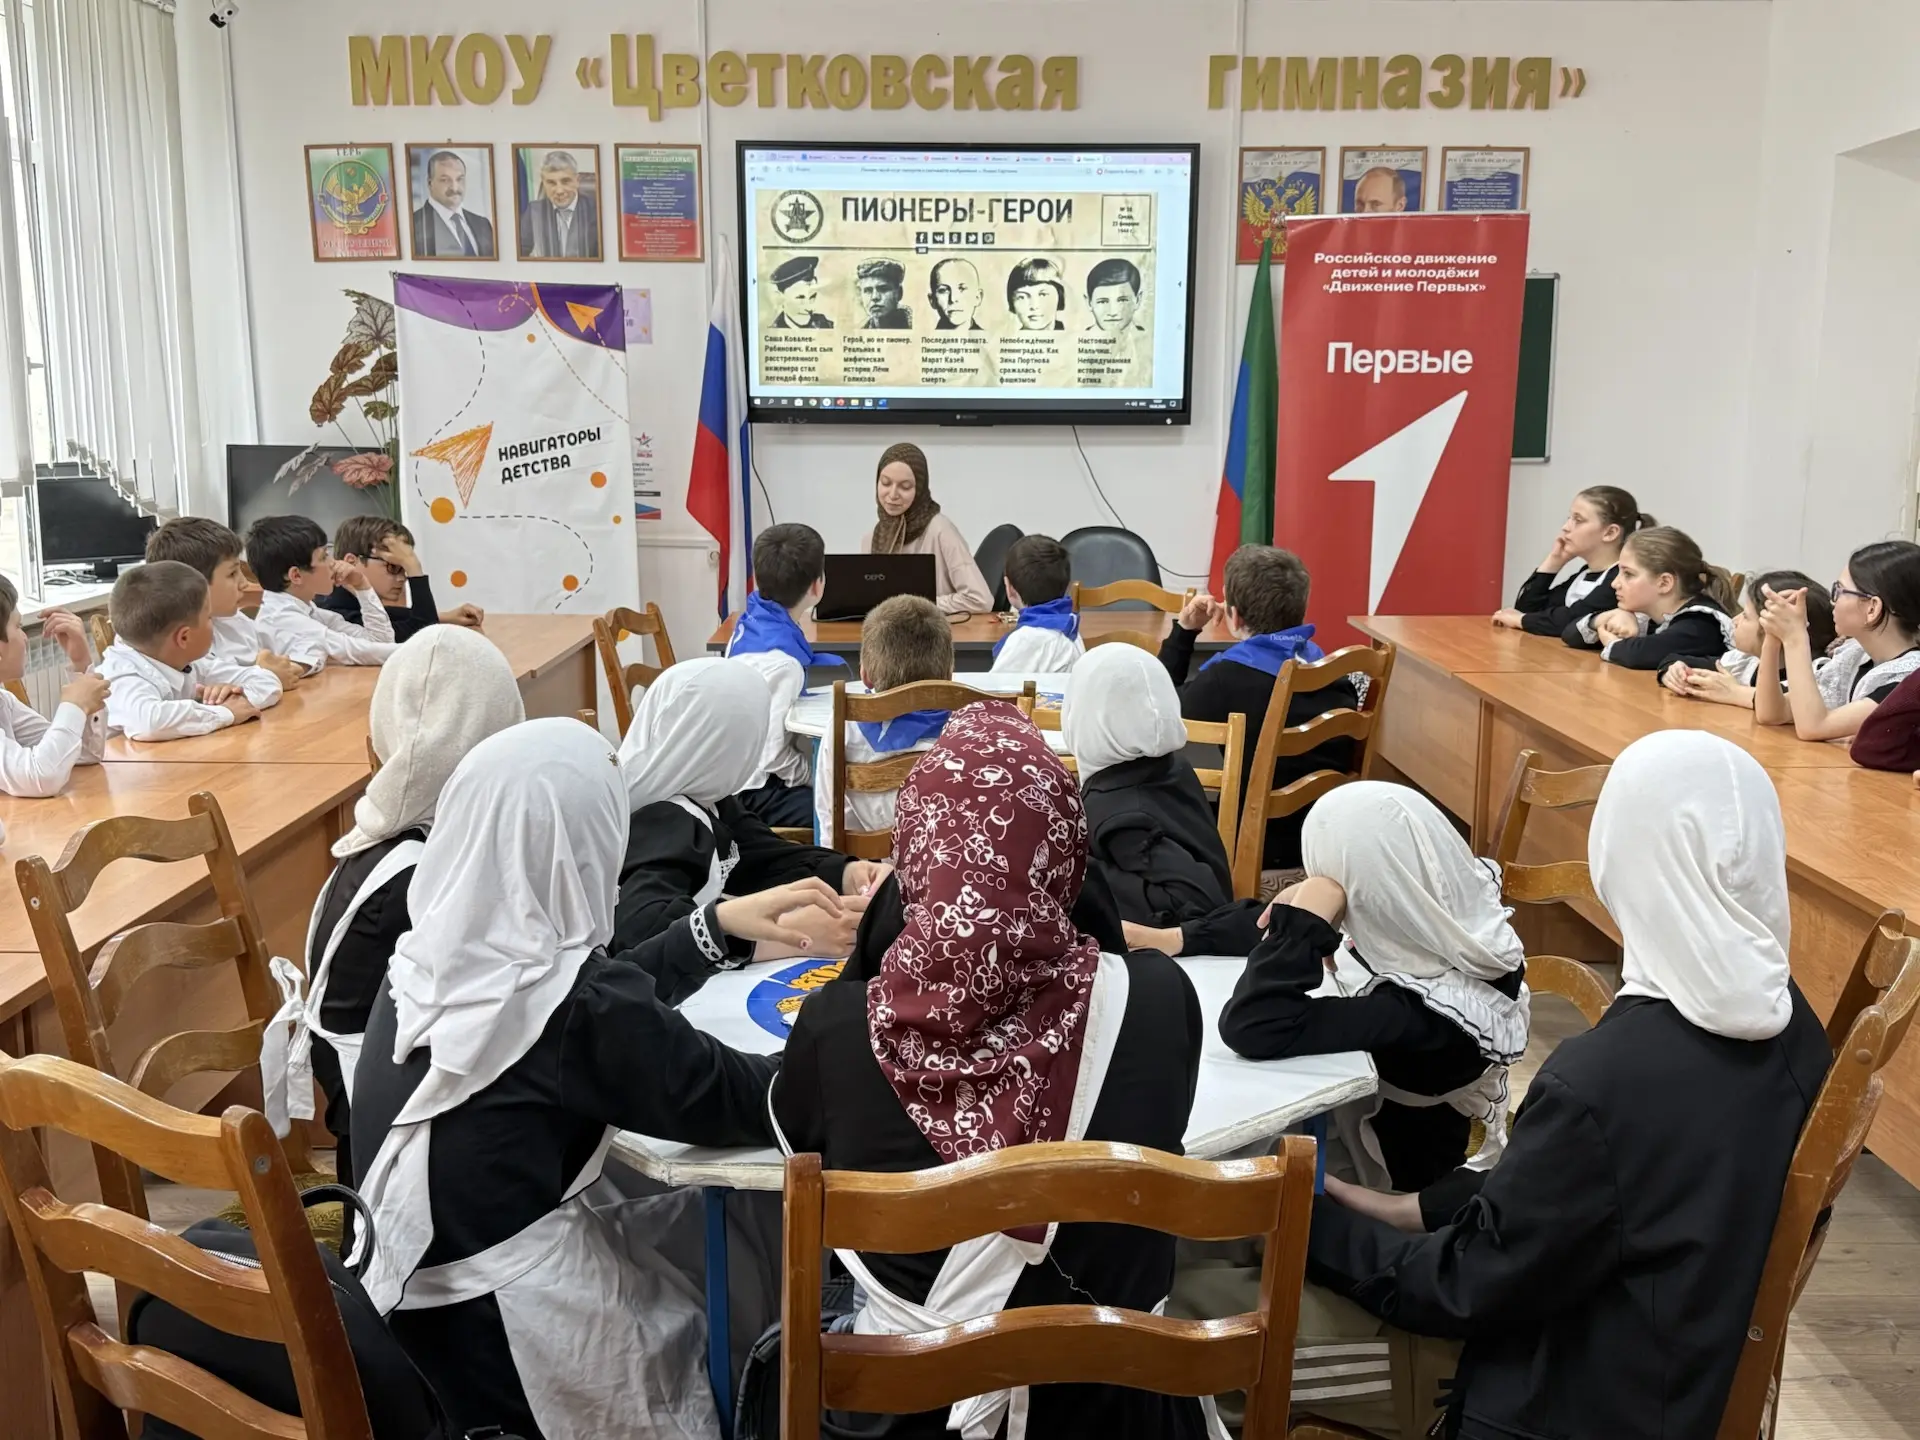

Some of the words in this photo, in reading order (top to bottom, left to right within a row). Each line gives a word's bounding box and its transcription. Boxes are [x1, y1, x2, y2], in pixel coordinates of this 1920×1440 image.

[348, 33, 551, 106] МКОУ
[575, 33, 1079, 122] «Цветковская
[1208, 54, 1587, 111] гимназия»
[842, 197, 1073, 223] ПИОНЕРЫ-ГЕРОИ
[1314, 252, 1412, 264] Российское
[1414, 254, 1497, 265] движение
[1331, 266, 1379, 278] детей
[1381, 269, 1392, 278] и
[1395, 266, 1480, 278] молодёжи
[1323, 281, 1414, 293] «Движение
[1417, 280, 1486, 294] Первых»
[843, 335, 865, 344] Герой,
[886, 337, 912, 345] пионер.
[921, 336, 958, 344] Последняя
[960, 337, 989, 345] граната.
[1327, 341, 1473, 383] Первые
[798, 374, 819, 382] флота
[498, 426, 601, 462] НАВИГАТОРЫ
[501, 454, 571, 484] ДЕТСТВА
[962, 870, 1006, 890] COCO
